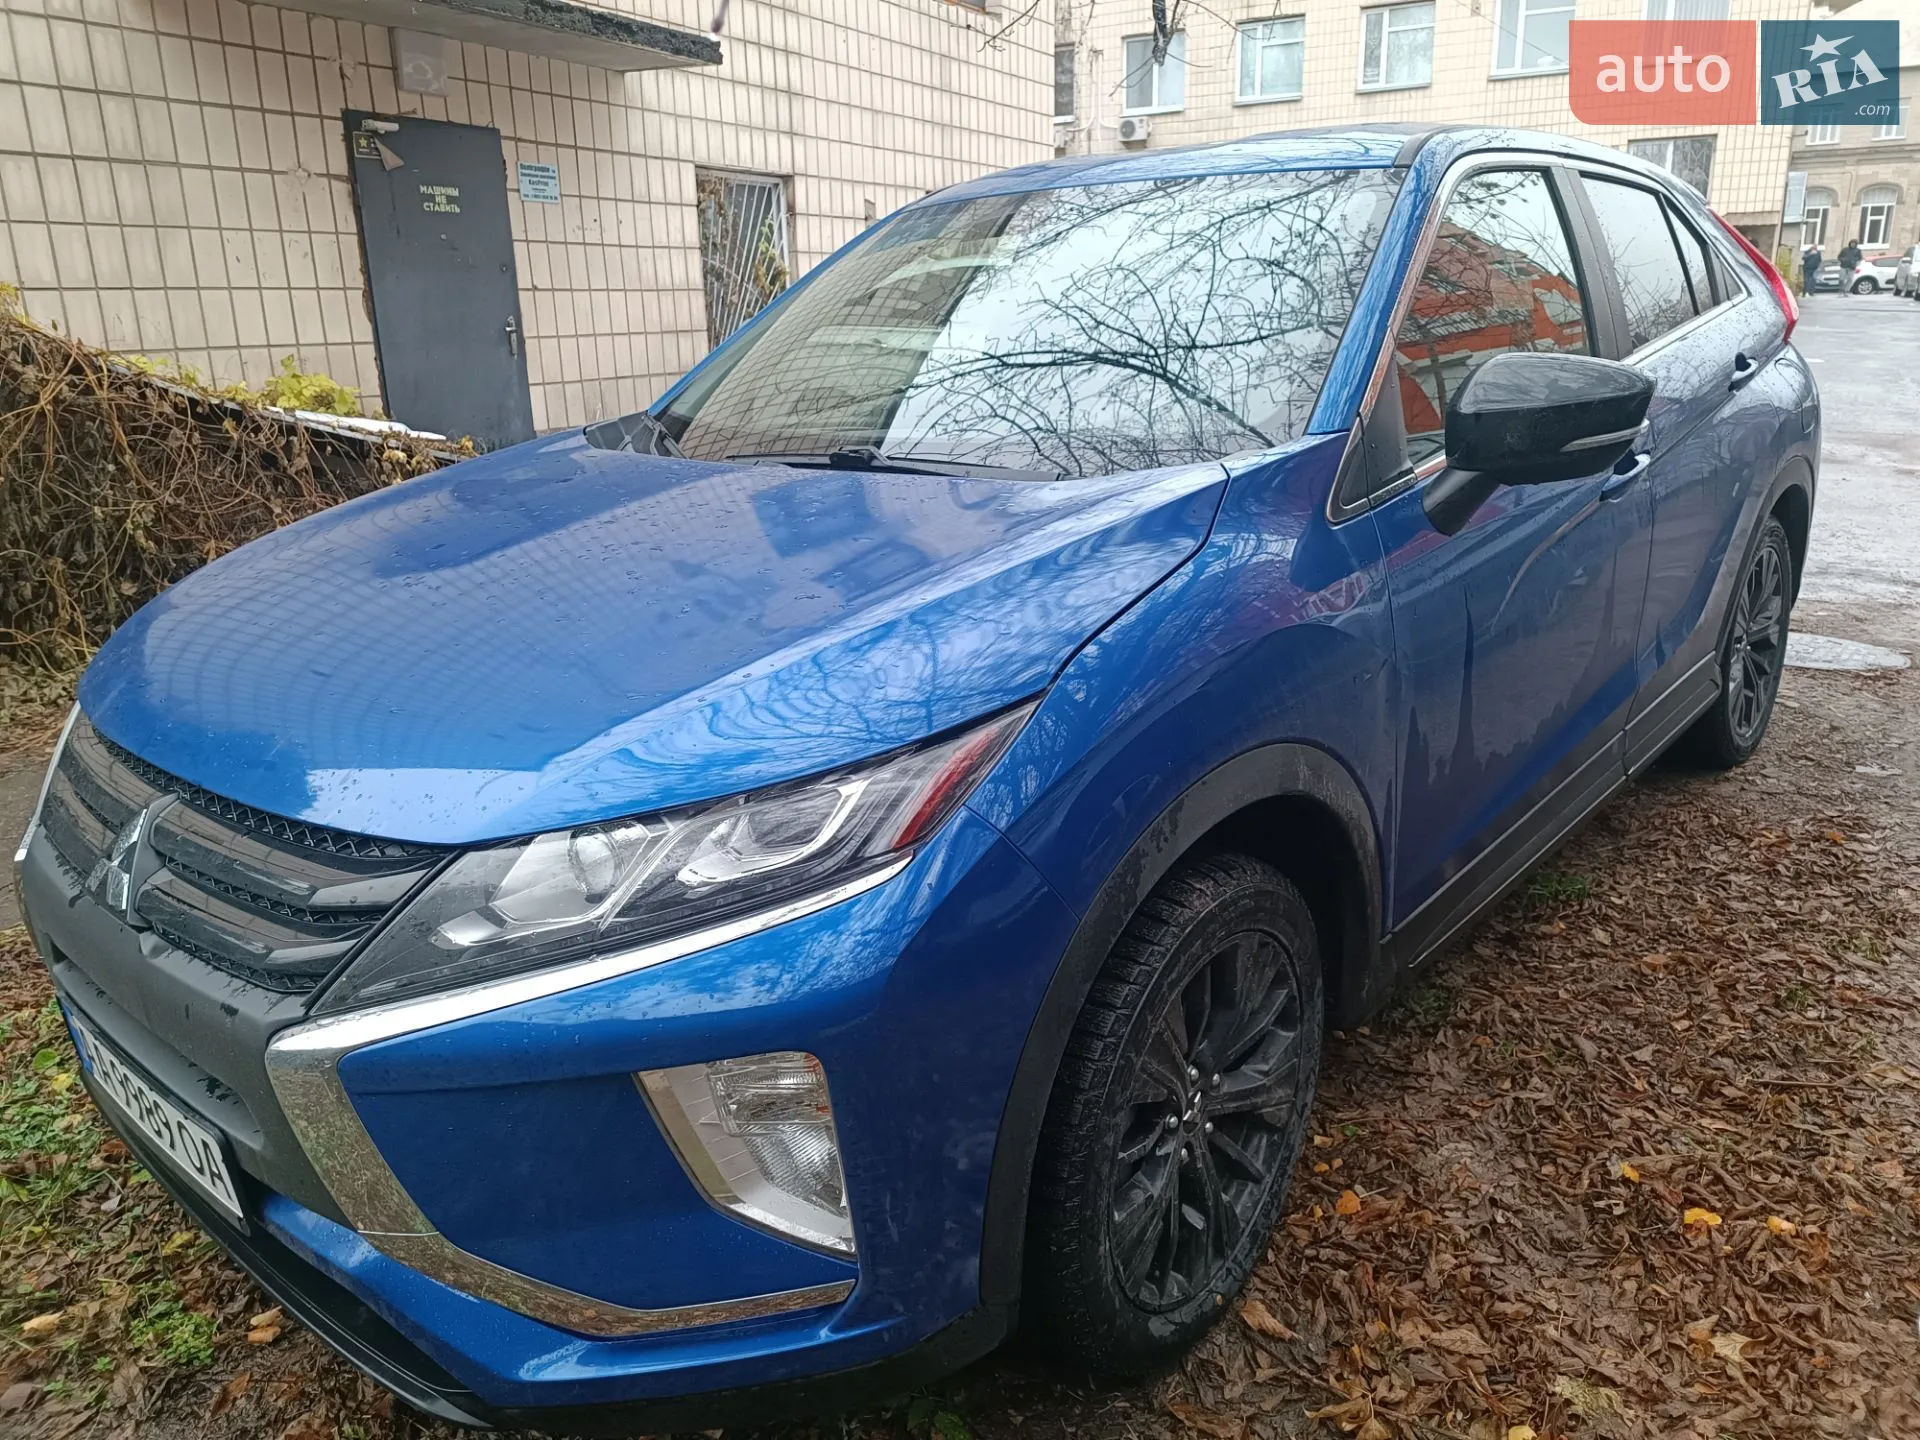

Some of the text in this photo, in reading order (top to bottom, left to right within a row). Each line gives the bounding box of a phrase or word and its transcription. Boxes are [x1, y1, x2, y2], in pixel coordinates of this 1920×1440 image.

[419, 184, 459, 197] МАШИНЫ
[434, 194, 447, 204] НЕ
[423, 202, 461, 213] СТАВИТЬ
[110, 1059, 176, 1151] 9989
[176, 1120, 233, 1200] OA
